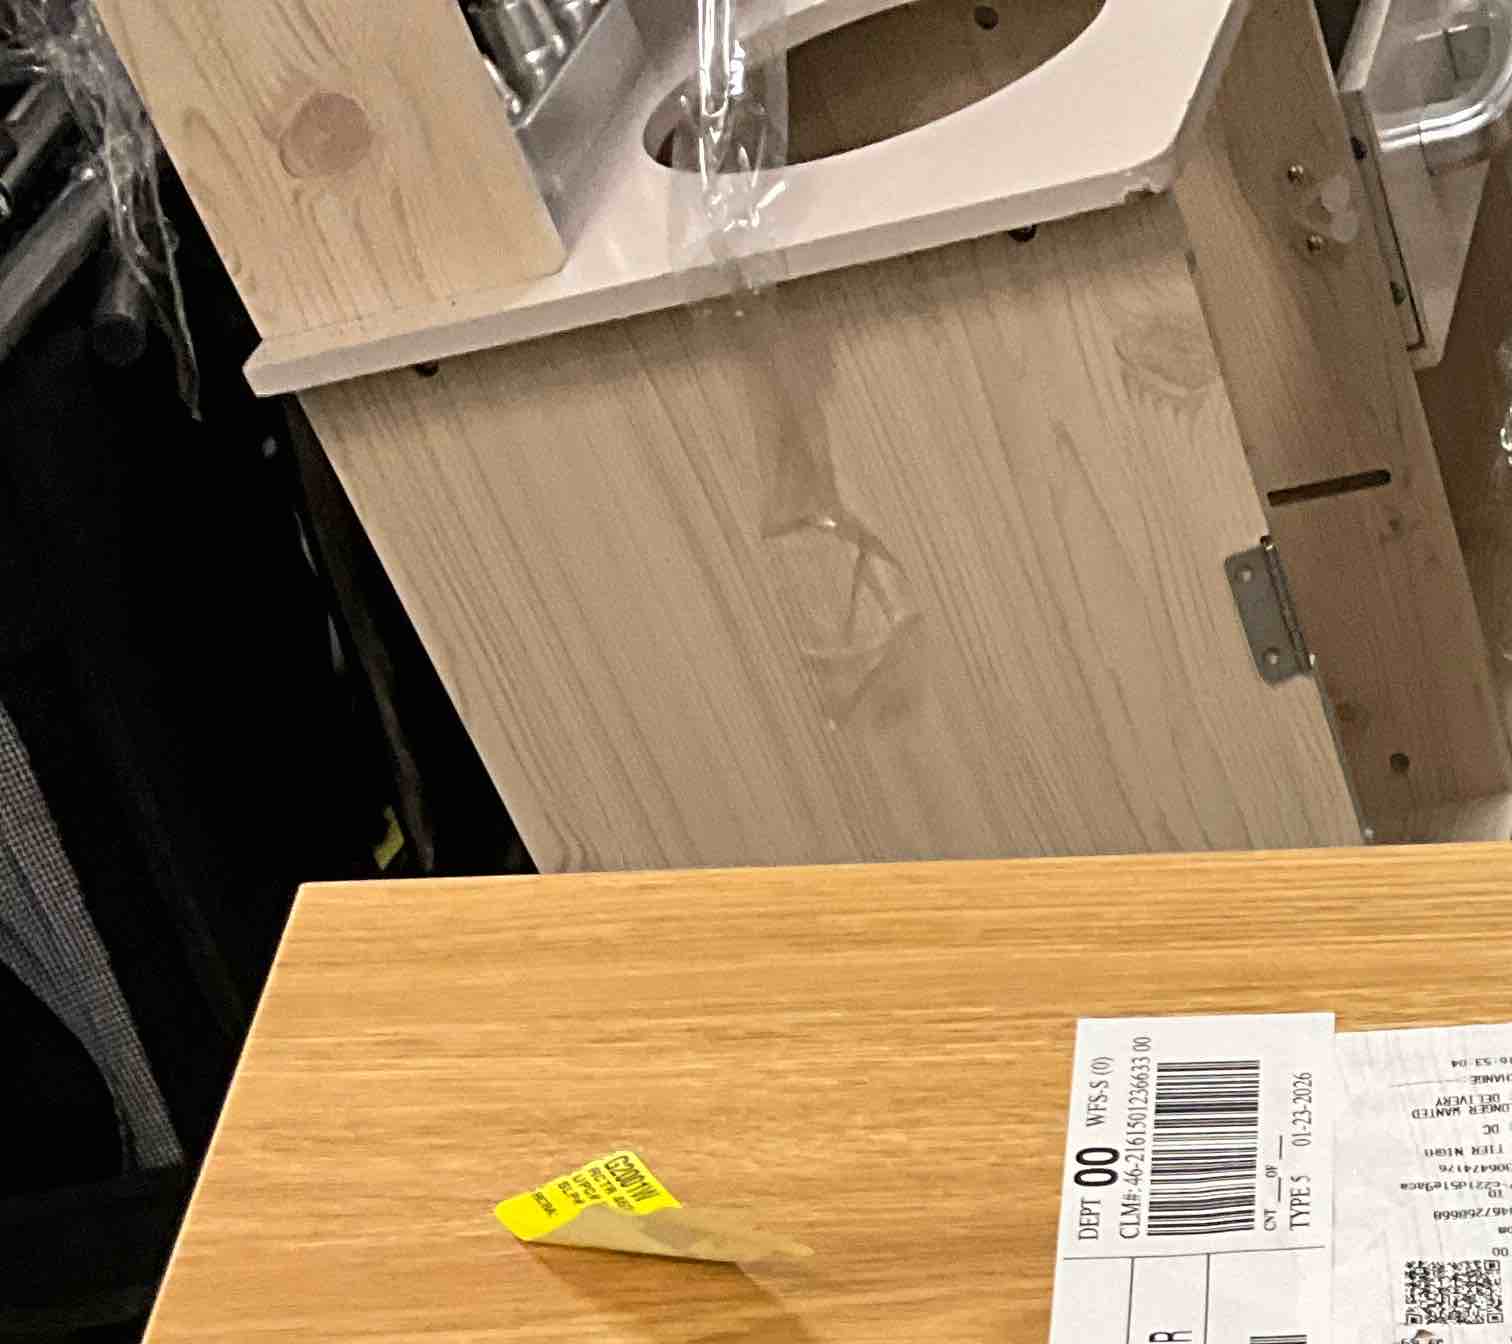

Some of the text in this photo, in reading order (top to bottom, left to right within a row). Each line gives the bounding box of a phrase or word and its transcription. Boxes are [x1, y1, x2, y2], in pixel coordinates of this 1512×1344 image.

[1133, 1037, 1151, 1051] 00
[1436, 1094, 1500, 1106] DELIVERY
[1292, 1072, 1312, 1146] 01-23-2026
[1411, 1107, 1460, 1119] WANTED
[1482, 1124, 1499, 1135] DC
[1073, 1057, 1119, 1240] DEPT 00 WFS-S (0)
[1472, 1144, 1504, 1155] TIER
[1264, 1165, 1278, 1231] CNT OF
[1488, 1190, 1502, 1198] ID
[1290, 1187, 1310, 1231] TYPE
[1492, 1248, 1508, 1256] 00
